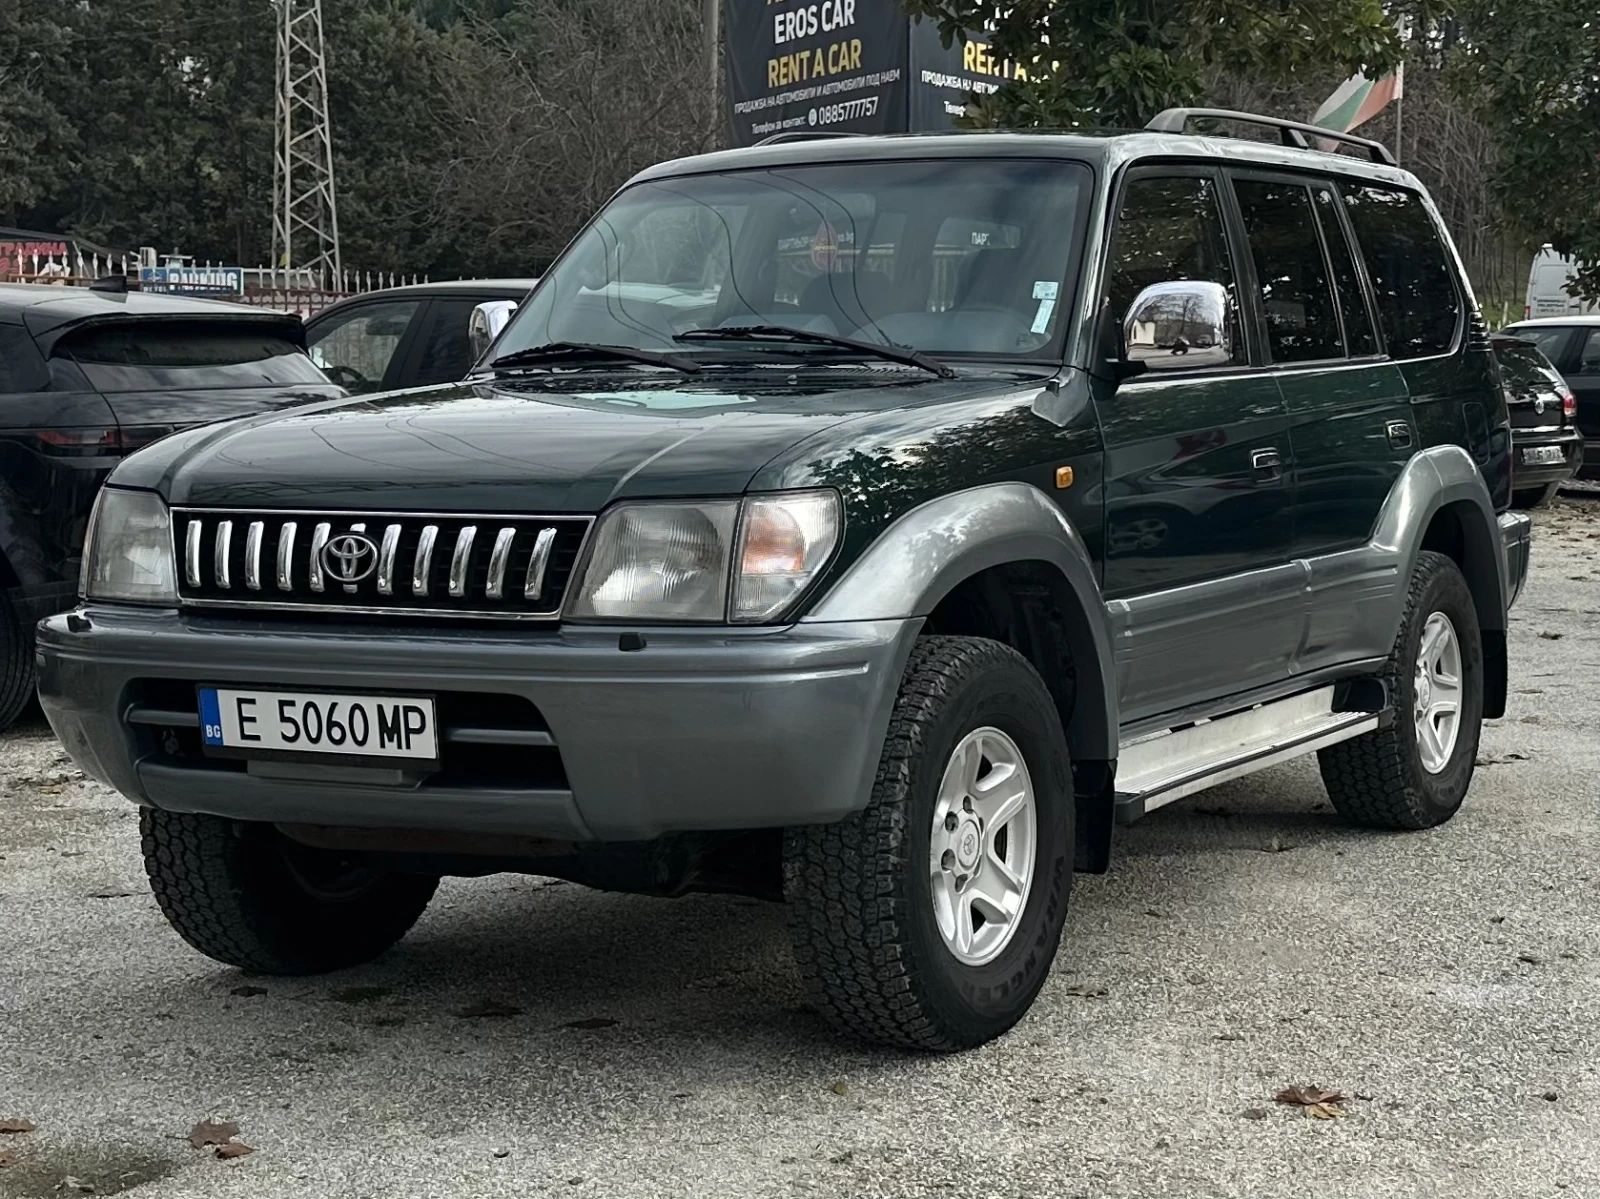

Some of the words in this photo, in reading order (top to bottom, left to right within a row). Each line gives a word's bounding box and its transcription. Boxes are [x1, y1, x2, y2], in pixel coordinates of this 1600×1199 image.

[774, 4, 818, 44] EROS
[821, 0, 855, 32] CAR
[767, 50, 811, 88] RENT
[811, 47, 825, 79] A
[828, 38, 862, 74] CAR
[866, 73, 880, 87] ПОД
[921, 70, 961, 89] ПРОДАЖБА
[818, 96, 879, 125] 0885777757
[205, 724, 221, 738] BG
[236, 697, 261, 742] E
[277, 699, 370, 747] 5060
[376, 703, 426, 750] MP
